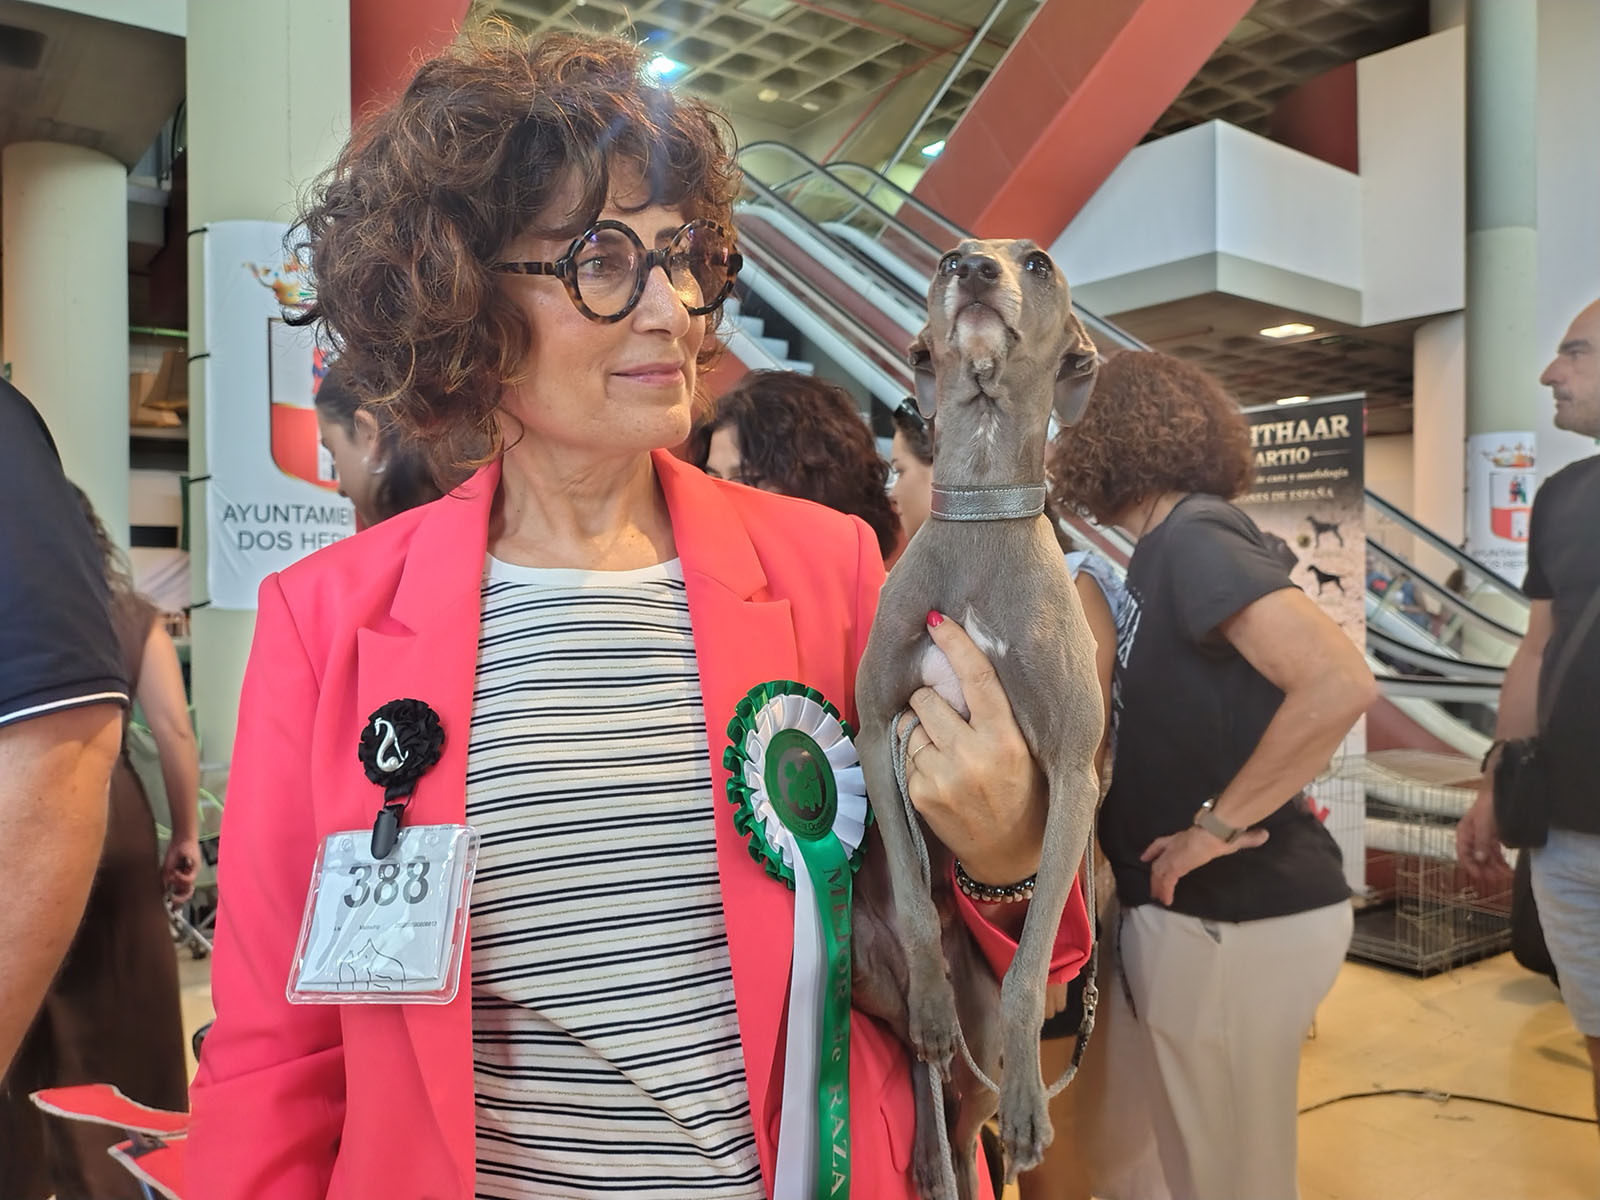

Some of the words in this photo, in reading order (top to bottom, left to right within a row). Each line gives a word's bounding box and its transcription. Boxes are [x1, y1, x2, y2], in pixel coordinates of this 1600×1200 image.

[223, 503, 354, 526] AYUNTAMIE
[238, 530, 293, 551] DOS
[343, 855, 431, 909] 388
[823, 867, 850, 1001] MEJOR
[831, 1025, 849, 1062] de
[828, 1083, 848, 1197] RAZA
